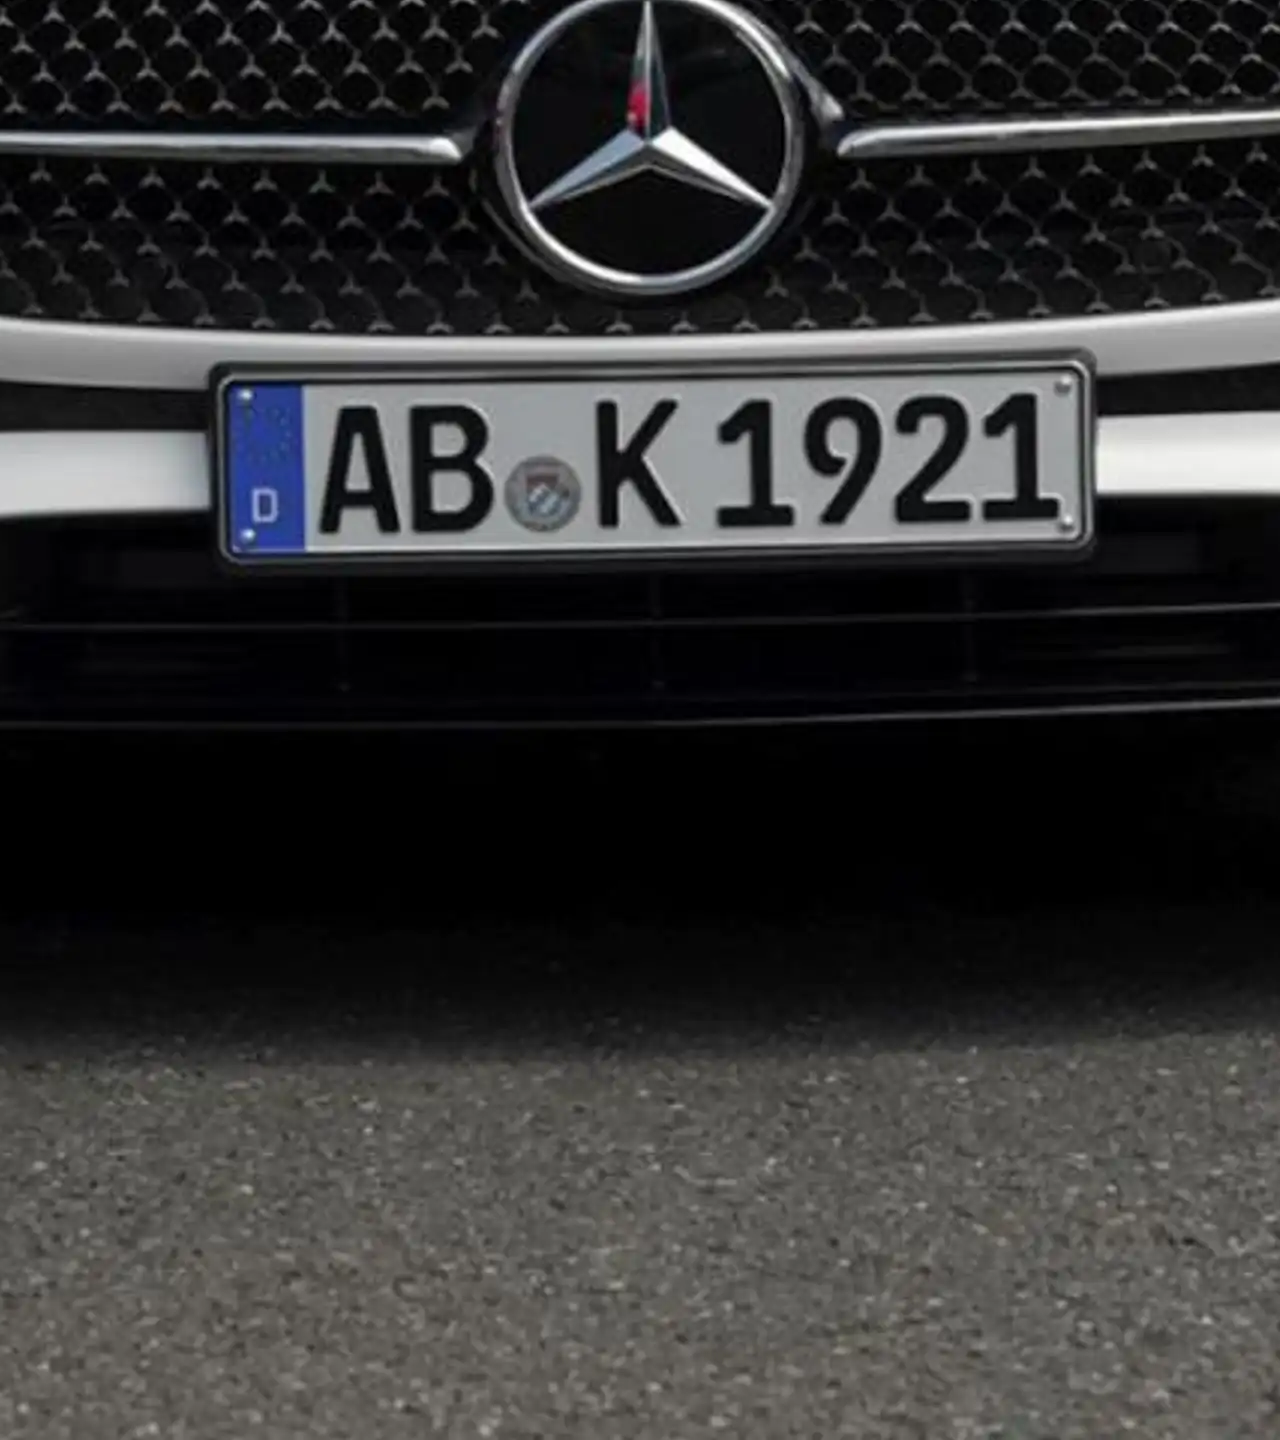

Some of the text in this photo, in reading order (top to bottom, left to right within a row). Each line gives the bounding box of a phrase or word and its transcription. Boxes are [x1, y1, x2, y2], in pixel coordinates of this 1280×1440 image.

[252, 488, 278, 523] D
[318, 392, 1060, 535] AB K 1921
